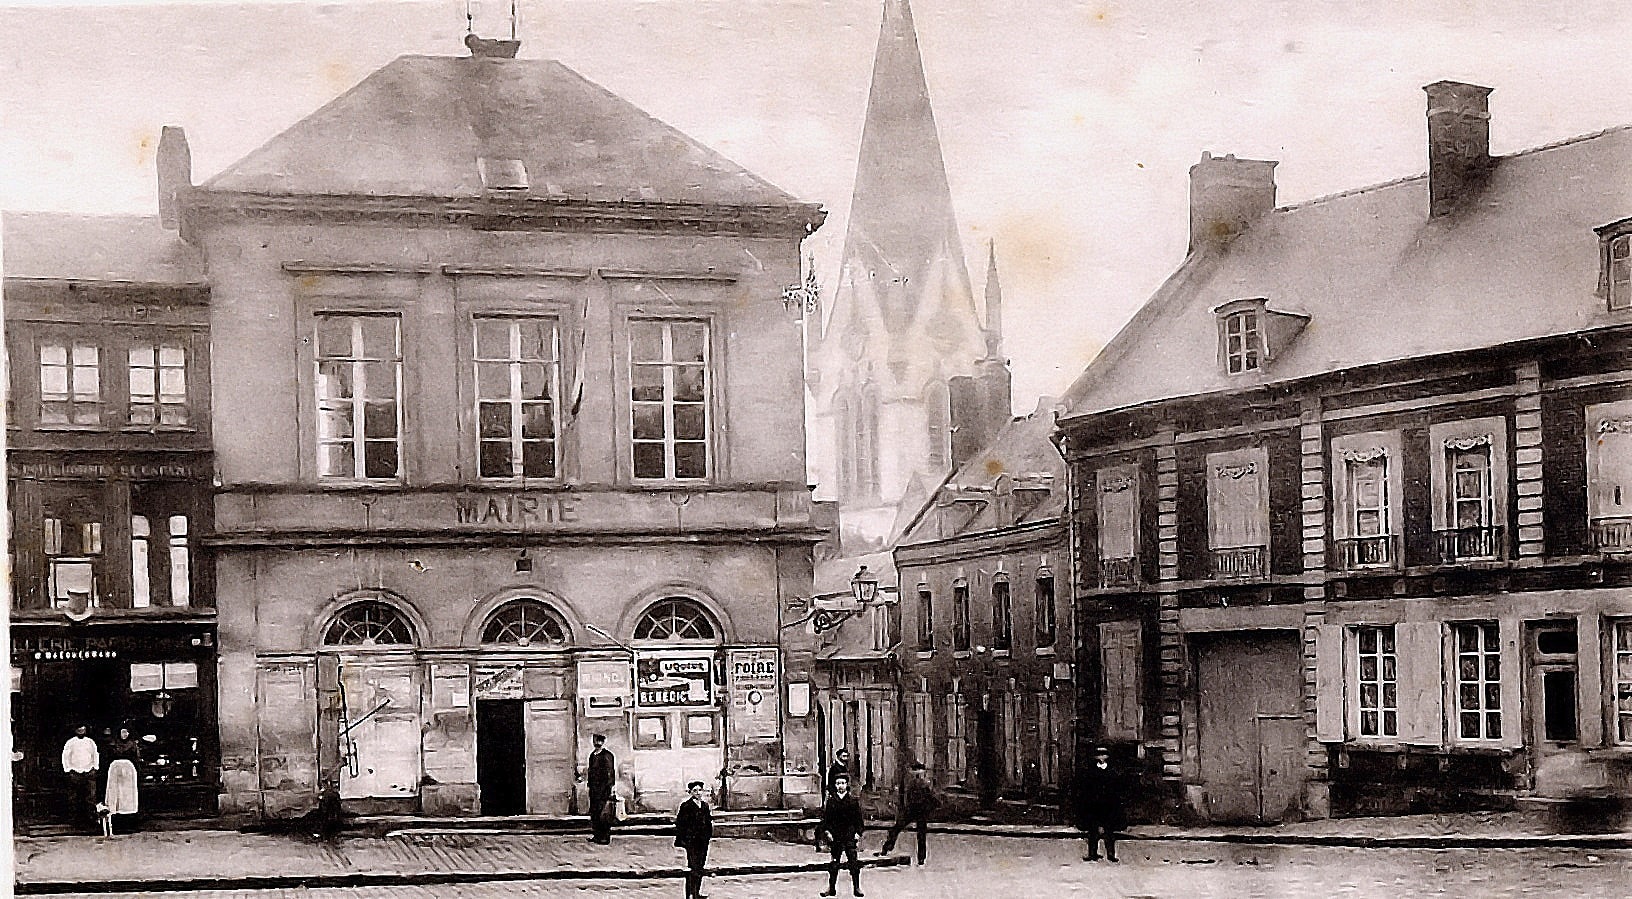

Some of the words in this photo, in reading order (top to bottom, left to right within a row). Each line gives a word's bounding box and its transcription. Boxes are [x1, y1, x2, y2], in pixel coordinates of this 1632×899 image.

[456, 496, 581, 523] MAIRIE
[734, 661, 775, 674] FOIRE
[640, 690, 709, 703] BENEDICE
